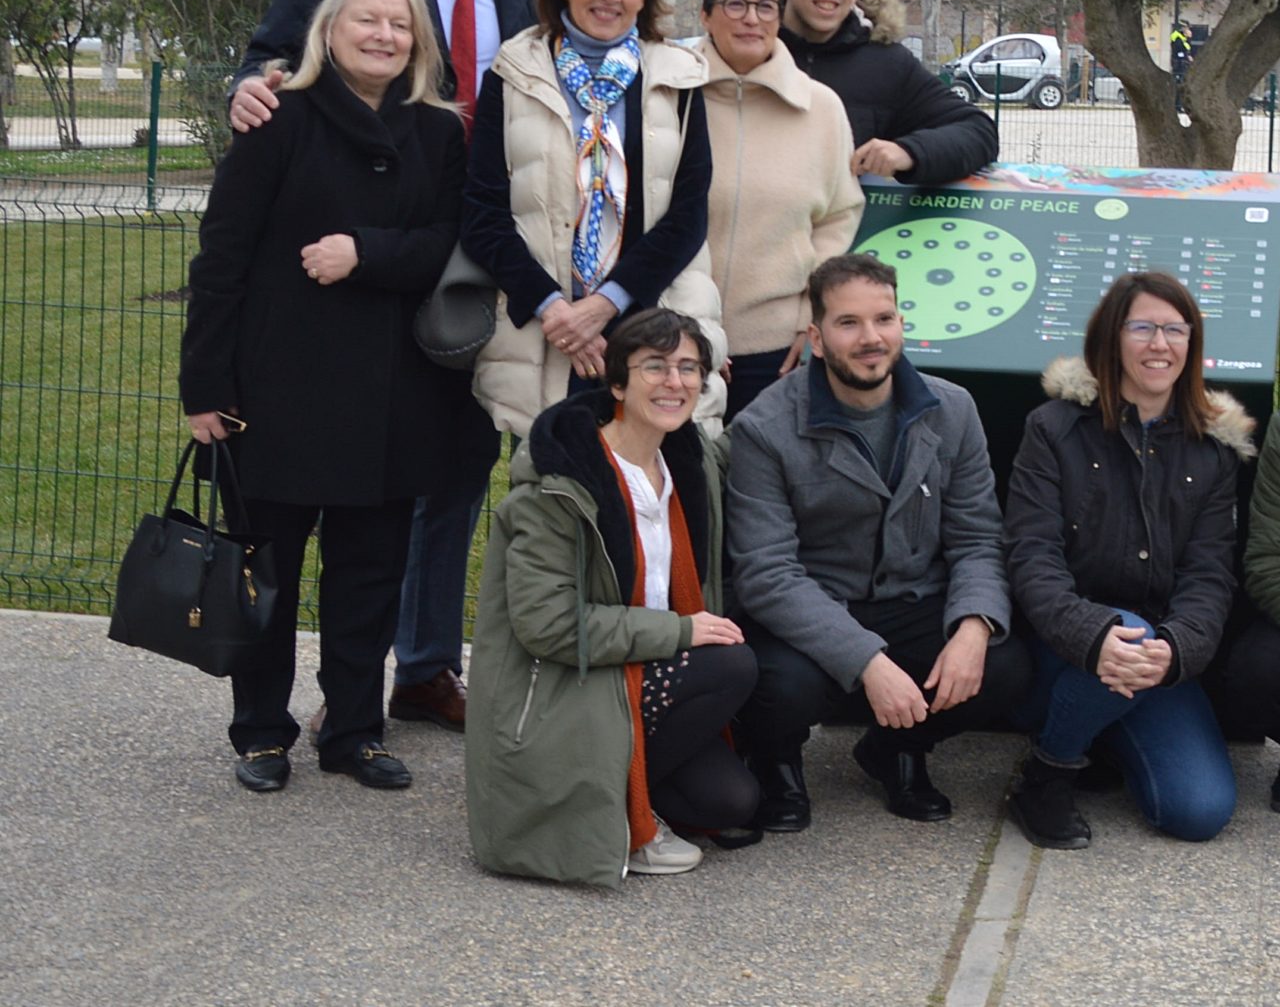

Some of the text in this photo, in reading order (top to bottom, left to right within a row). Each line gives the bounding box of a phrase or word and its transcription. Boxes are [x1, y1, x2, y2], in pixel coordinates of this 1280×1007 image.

[868, 192, 1080, 214] THE GARDEN OF PEACE
